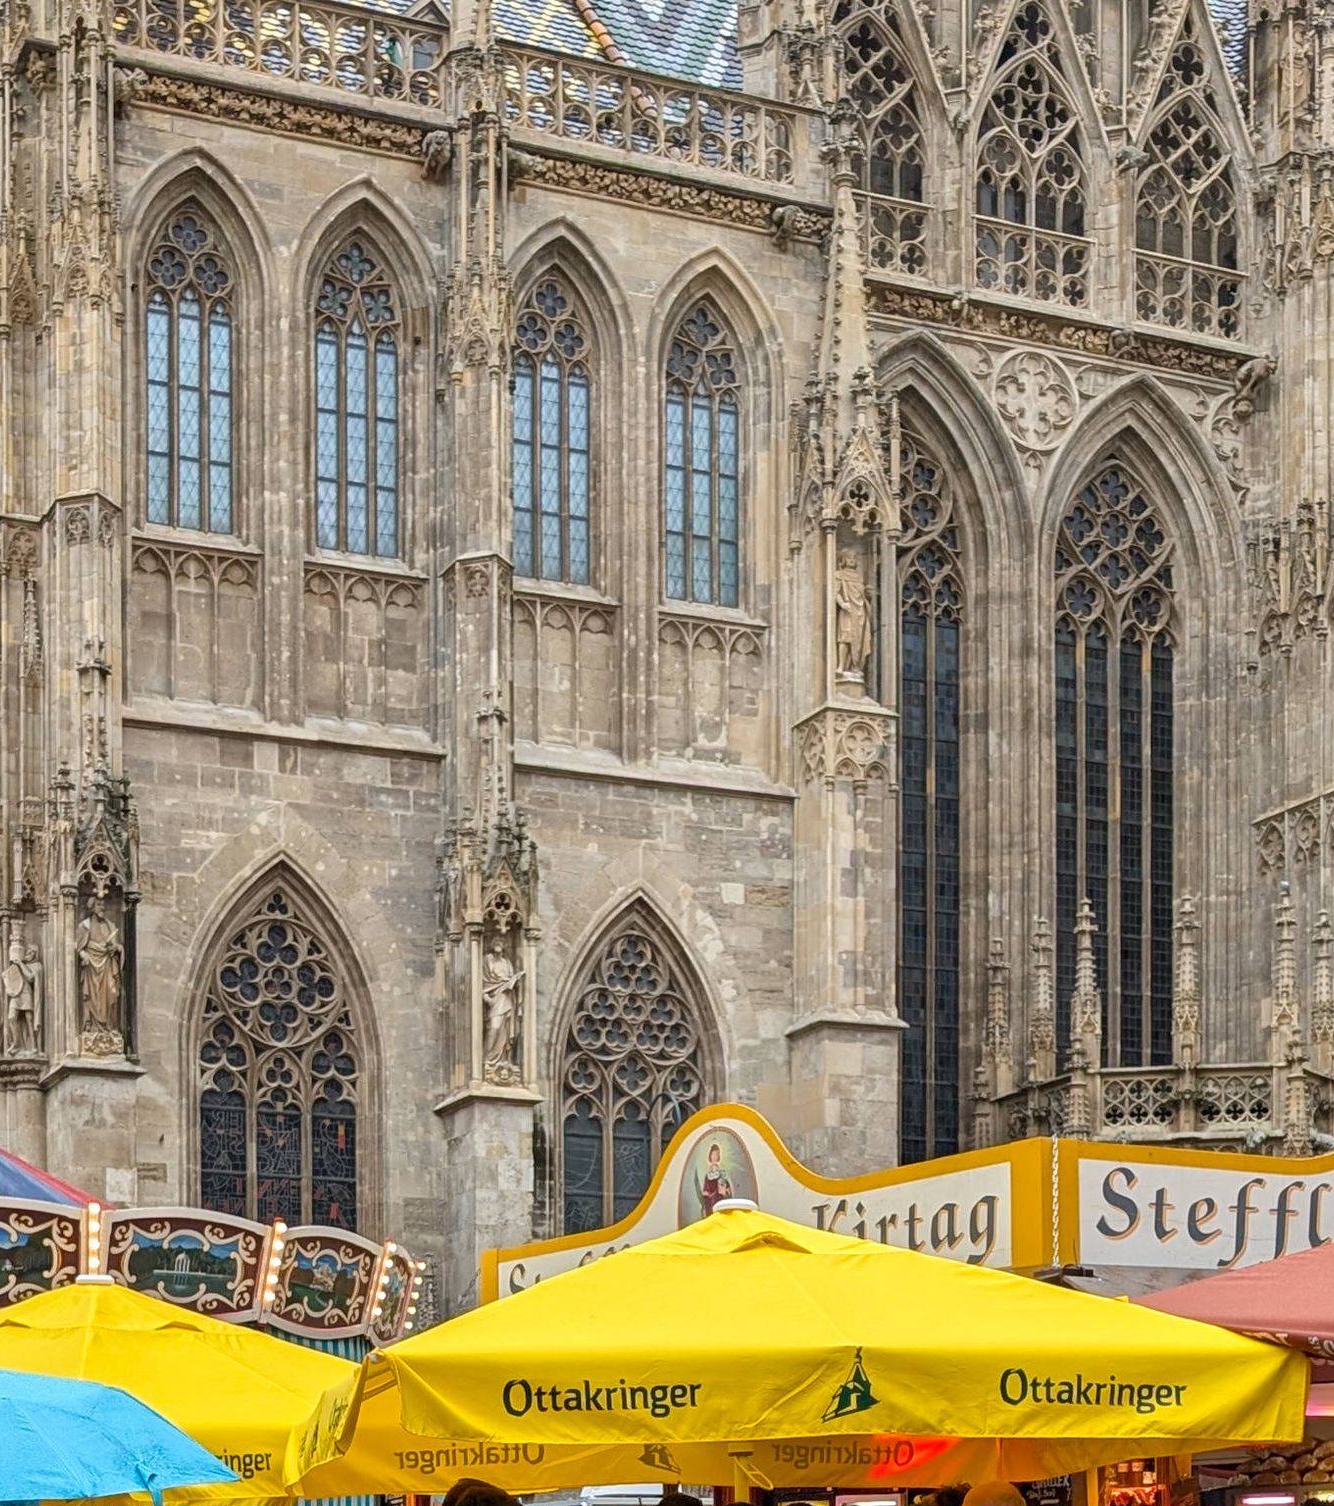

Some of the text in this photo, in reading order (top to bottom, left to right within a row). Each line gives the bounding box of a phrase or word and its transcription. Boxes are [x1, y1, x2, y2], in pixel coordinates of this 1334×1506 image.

[1096, 1167, 1333, 1268] Steffl
[502, 1378, 703, 1418] Ottakringer
[999, 1367, 1188, 1414] Ottakringer
